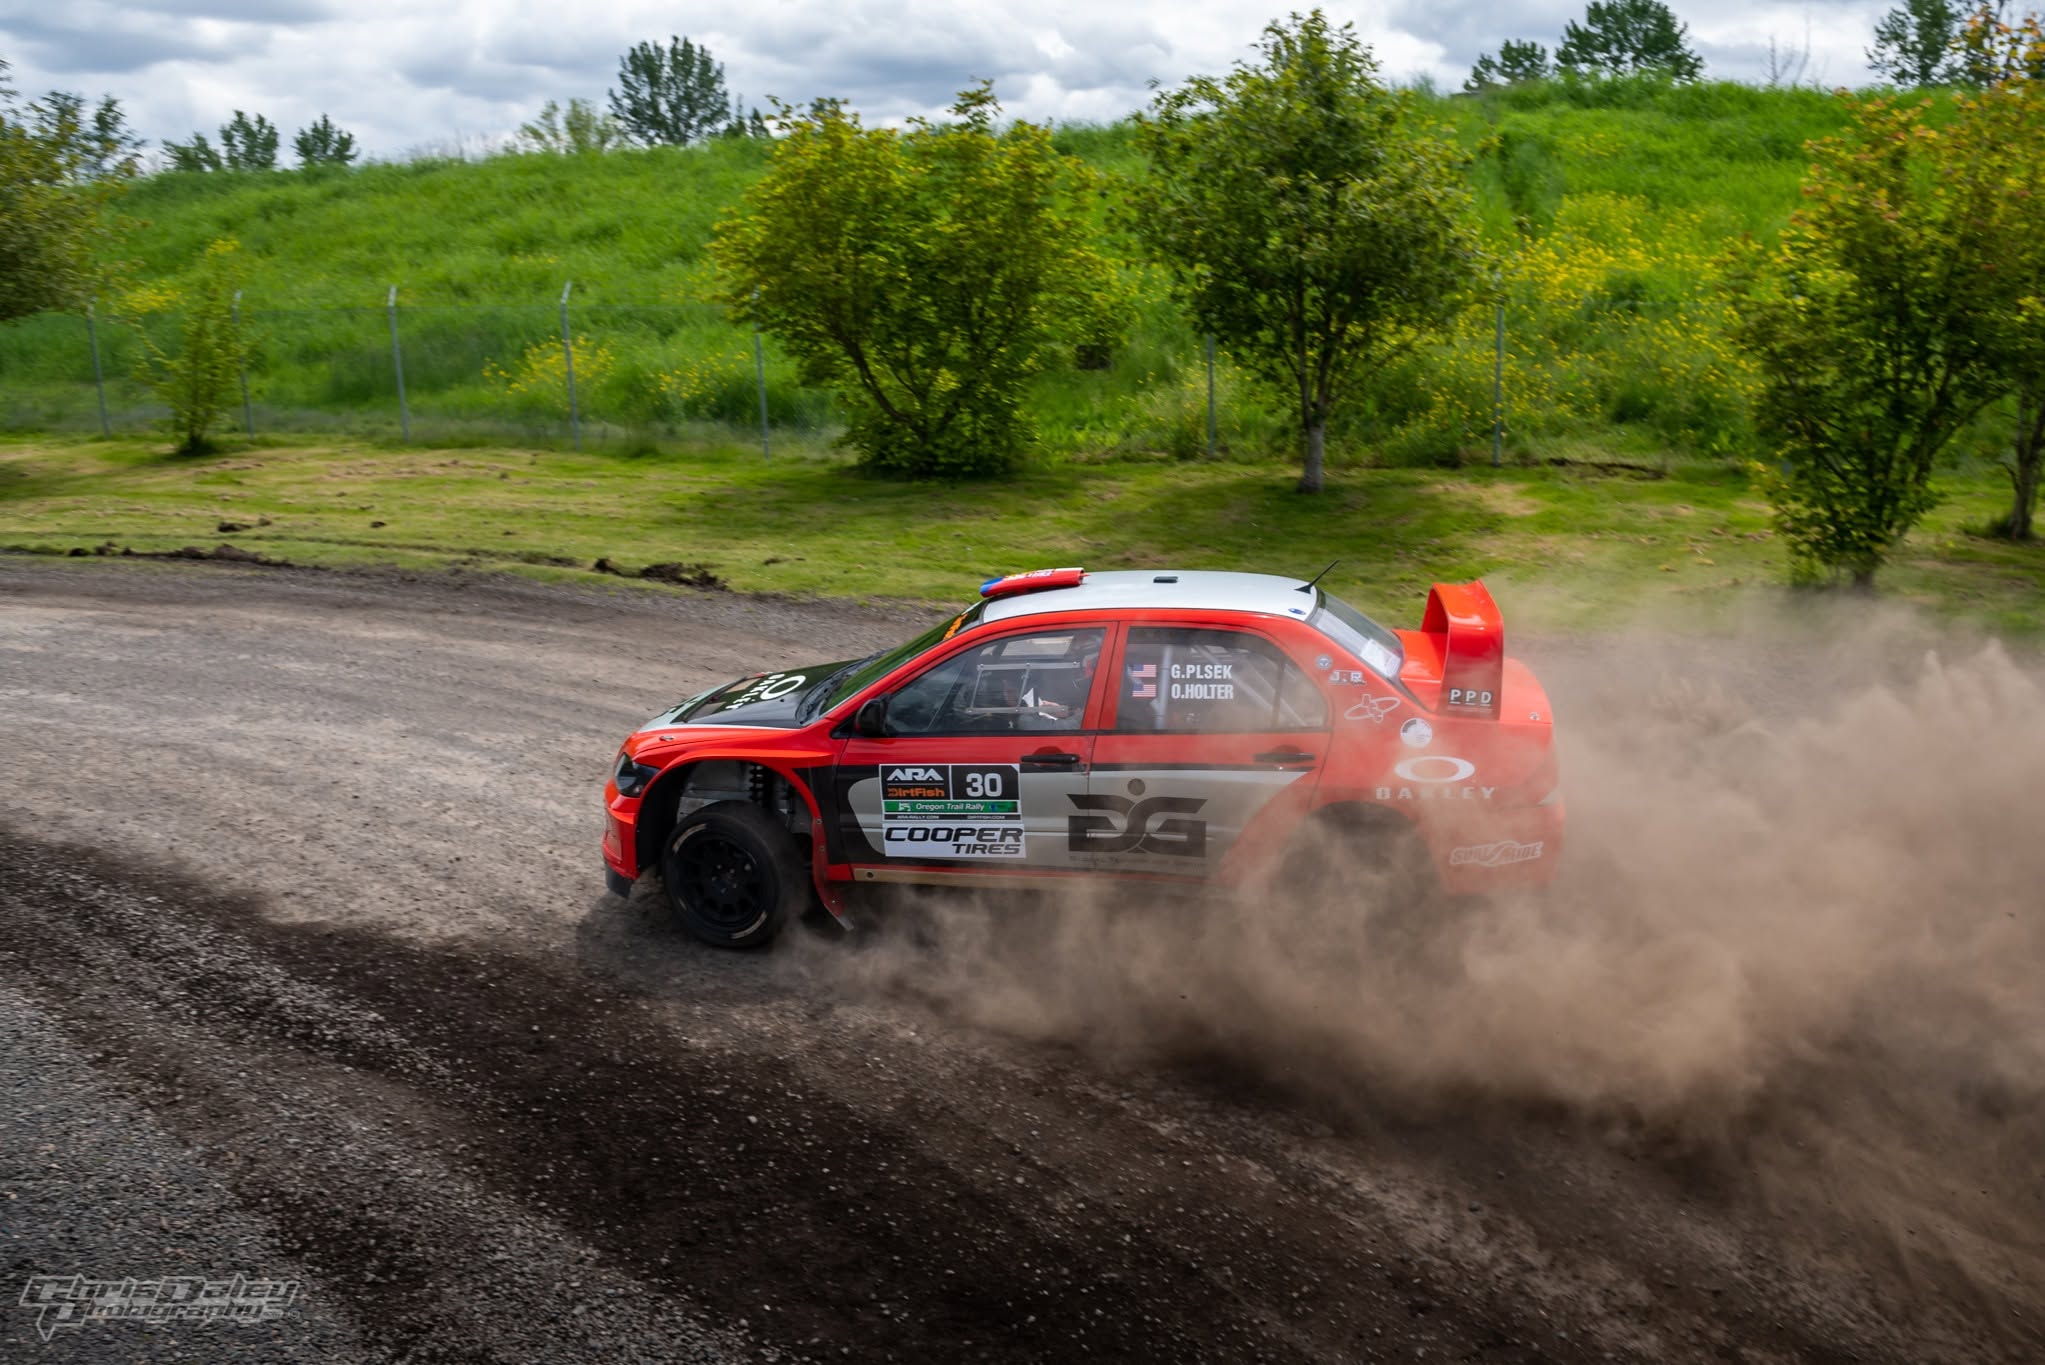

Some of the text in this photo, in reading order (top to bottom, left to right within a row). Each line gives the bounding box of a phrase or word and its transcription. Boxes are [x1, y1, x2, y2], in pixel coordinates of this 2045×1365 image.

[1171, 664, 1232, 679] G.PLSEK
[1171, 684, 1233, 699] O.HOLTER
[886, 768, 944, 781] ARA
[887, 787, 945, 797] DirtFish
[966, 773, 1003, 797] 30
[915, 802, 985, 811] Oregon Trail Rally
[885, 827, 1023, 842] COOPER
[952, 843, 1020, 855] TIRES
